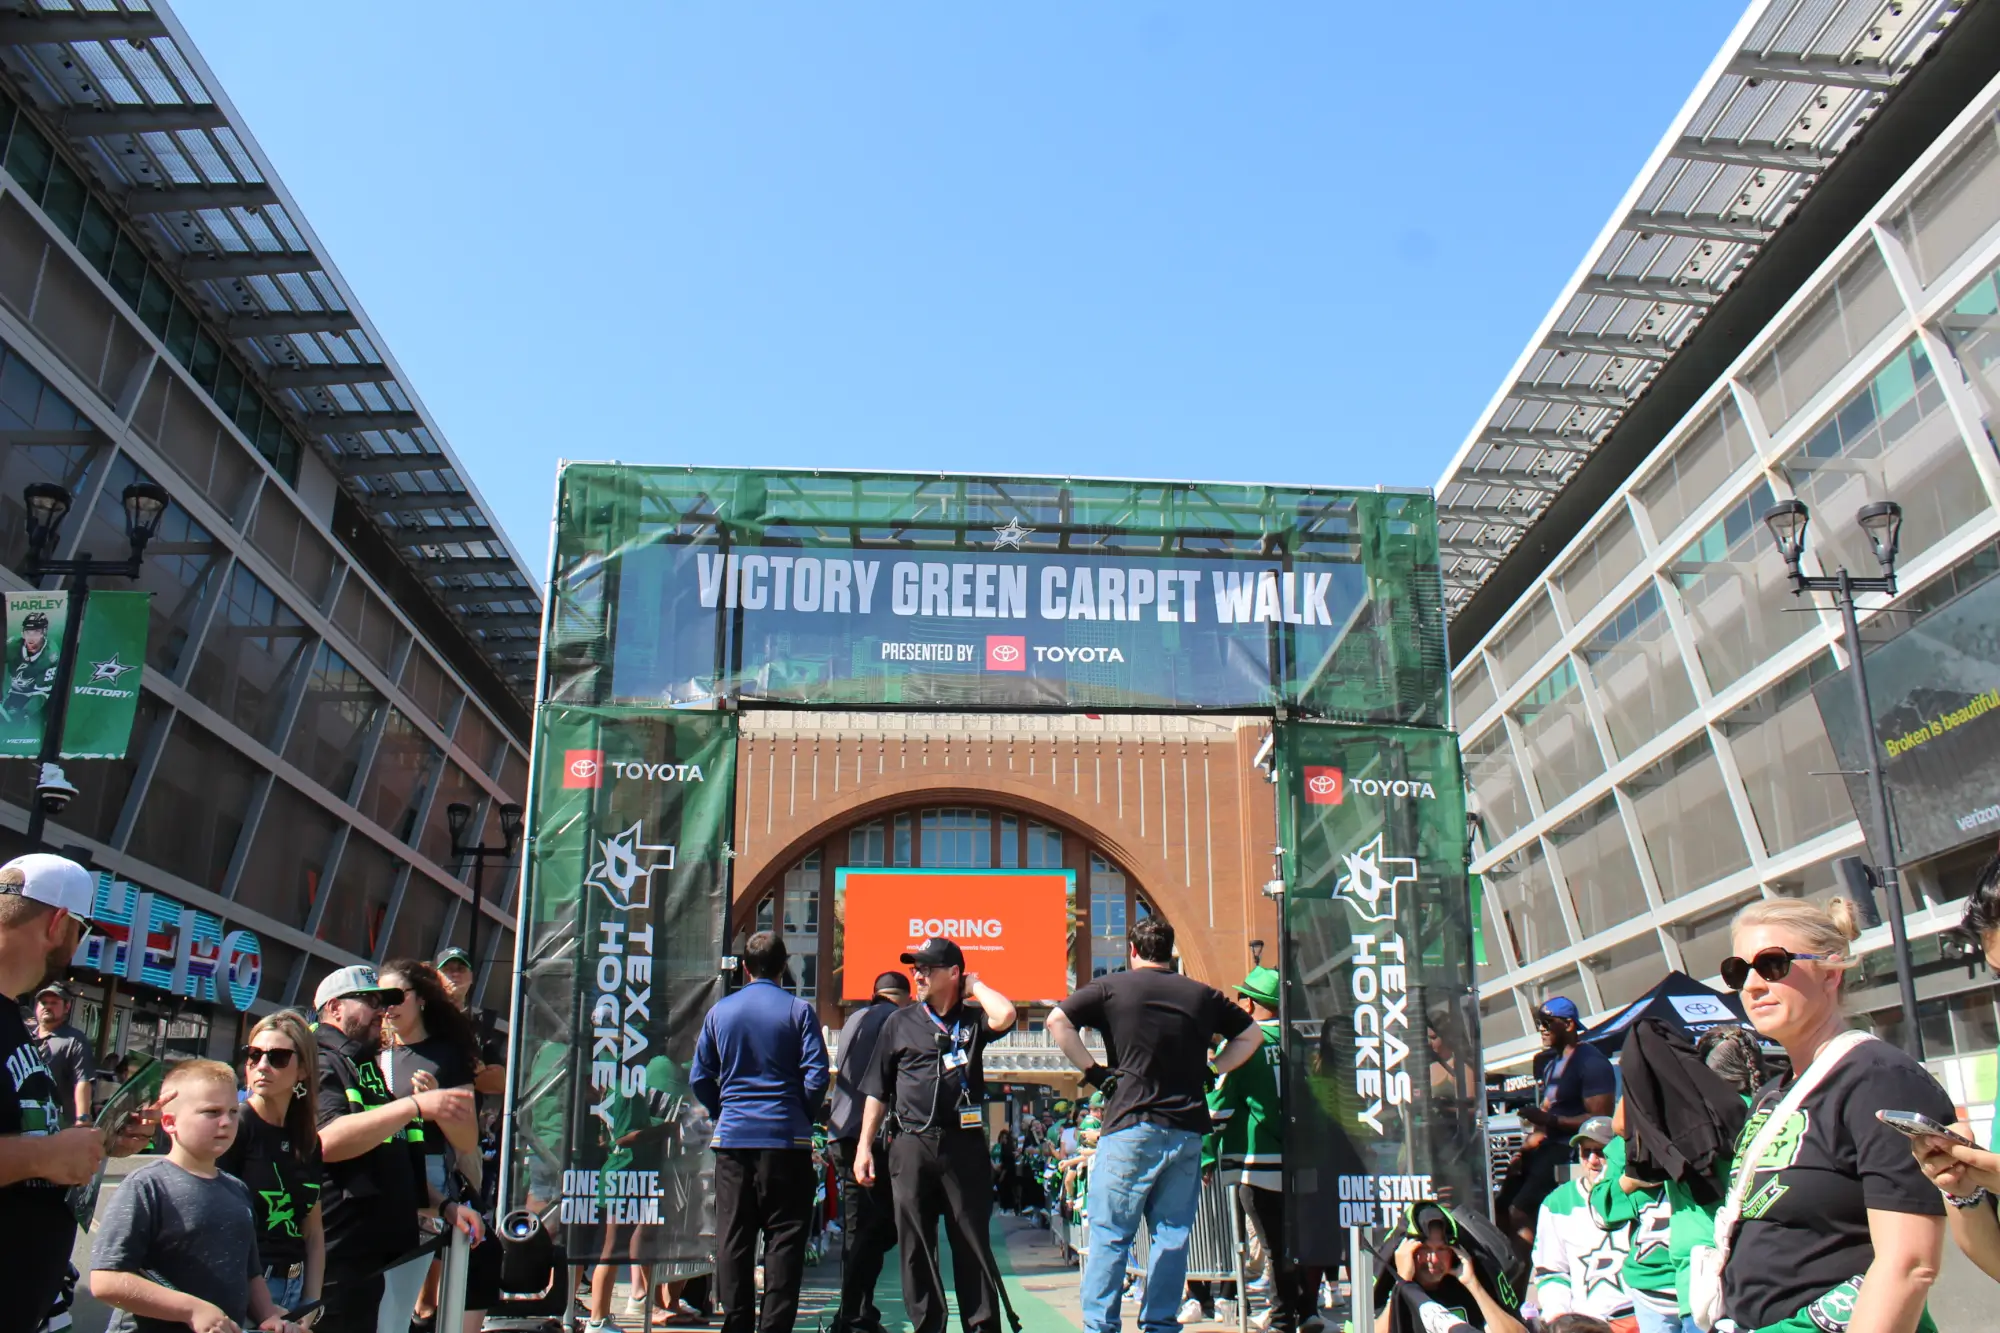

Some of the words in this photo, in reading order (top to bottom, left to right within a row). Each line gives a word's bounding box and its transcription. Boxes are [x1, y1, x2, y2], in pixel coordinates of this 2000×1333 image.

[697, 553, 880, 614] VICTORY
[891, 561, 1027, 619] GREEN
[1040, 566, 1200, 623] CARPET
[1212, 571, 1332, 625] WALK
[11, 599, 63, 611] HARLEY
[881, 642, 953, 661] PRESENTED
[956, 644, 974, 662] BY
[1033, 646, 1125, 663] TOYOTA
[74, 686, 130, 698] VICTORY
[1885, 731, 1931, 758] Broken
[1928, 720, 1943, 736] is
[612, 761, 704, 782] TOYOTA
[1349, 778, 1436, 799] TOYOTA
[1955, 804, 2000, 831] verizon
[76, 871, 262, 1011] HERO
[908, 918, 1003, 938] BORING
[621, 923, 654, 1098] TEXAS
[1380, 933, 1412, 1105] TEXAS
[590, 922, 625, 1129] HOCKEY
[1351, 934, 1384, 1136] HOCKEY
[563, 1170, 600, 1196] ONE
[605, 1170, 665, 1196] STATE.
[1338, 1175, 1375, 1200] ONE
[1378, 1175, 1438, 1200] STATE.
[560, 1198, 600, 1224] ONE
[605, 1198, 665, 1224] TEAM.
